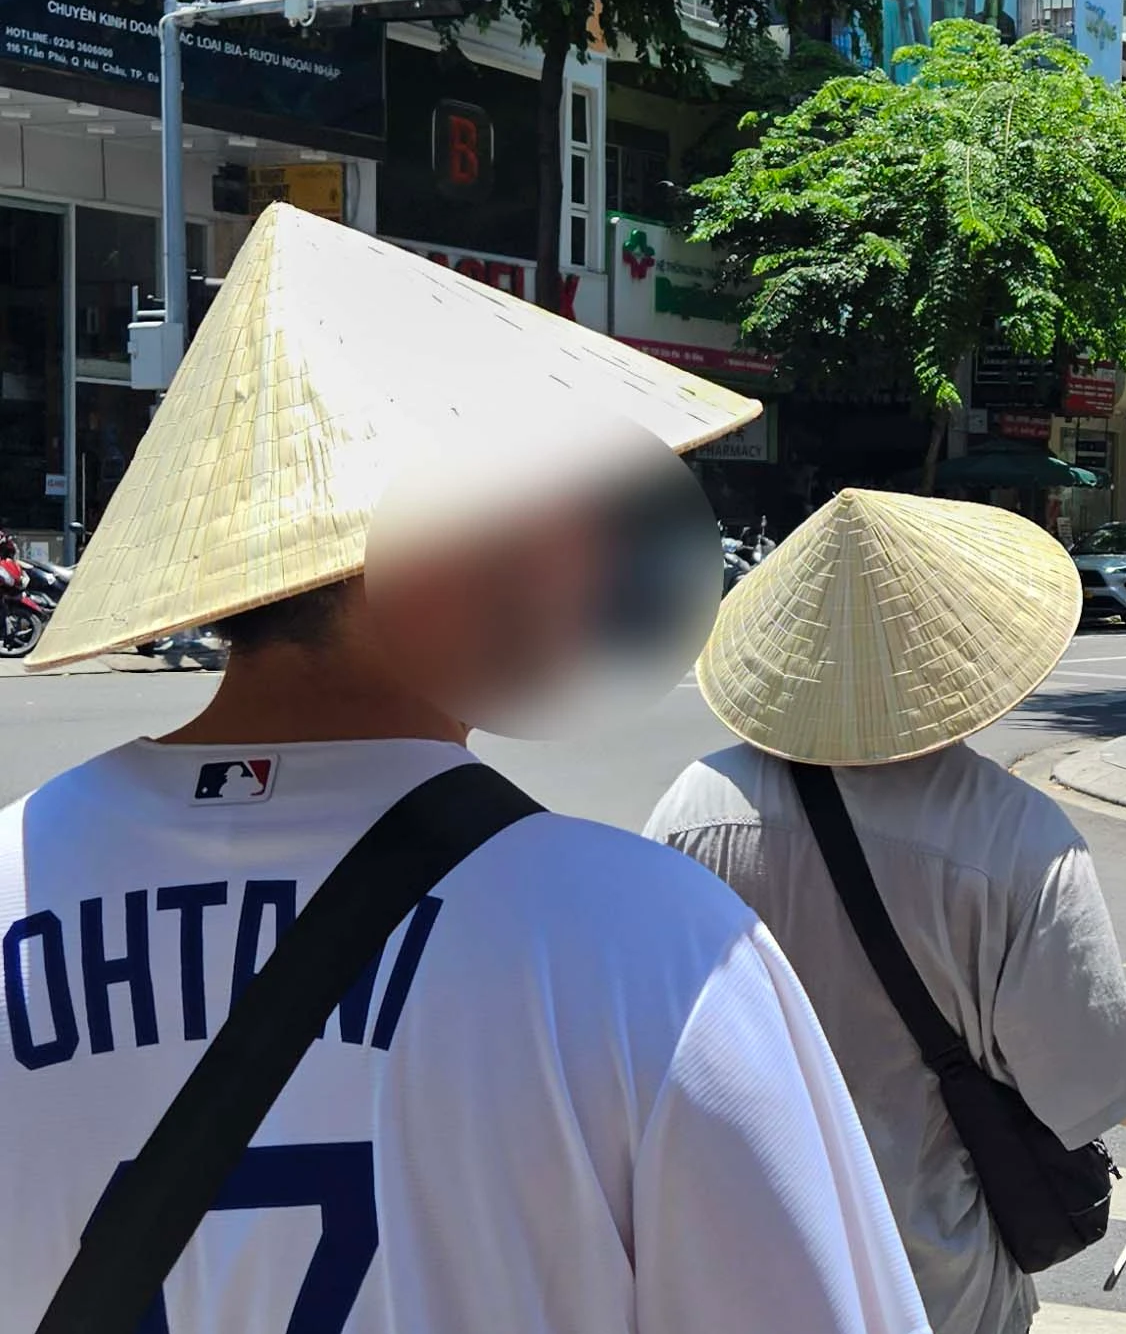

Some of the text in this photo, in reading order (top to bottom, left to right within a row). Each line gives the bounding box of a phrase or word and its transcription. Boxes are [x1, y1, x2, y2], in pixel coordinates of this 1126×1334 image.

[47, 0, 97, 24] CHUYÊN
[99, 11, 128, 31] KINH
[197, 35, 222, 54] LOẠI
[224, 42, 242, 57] BIA
